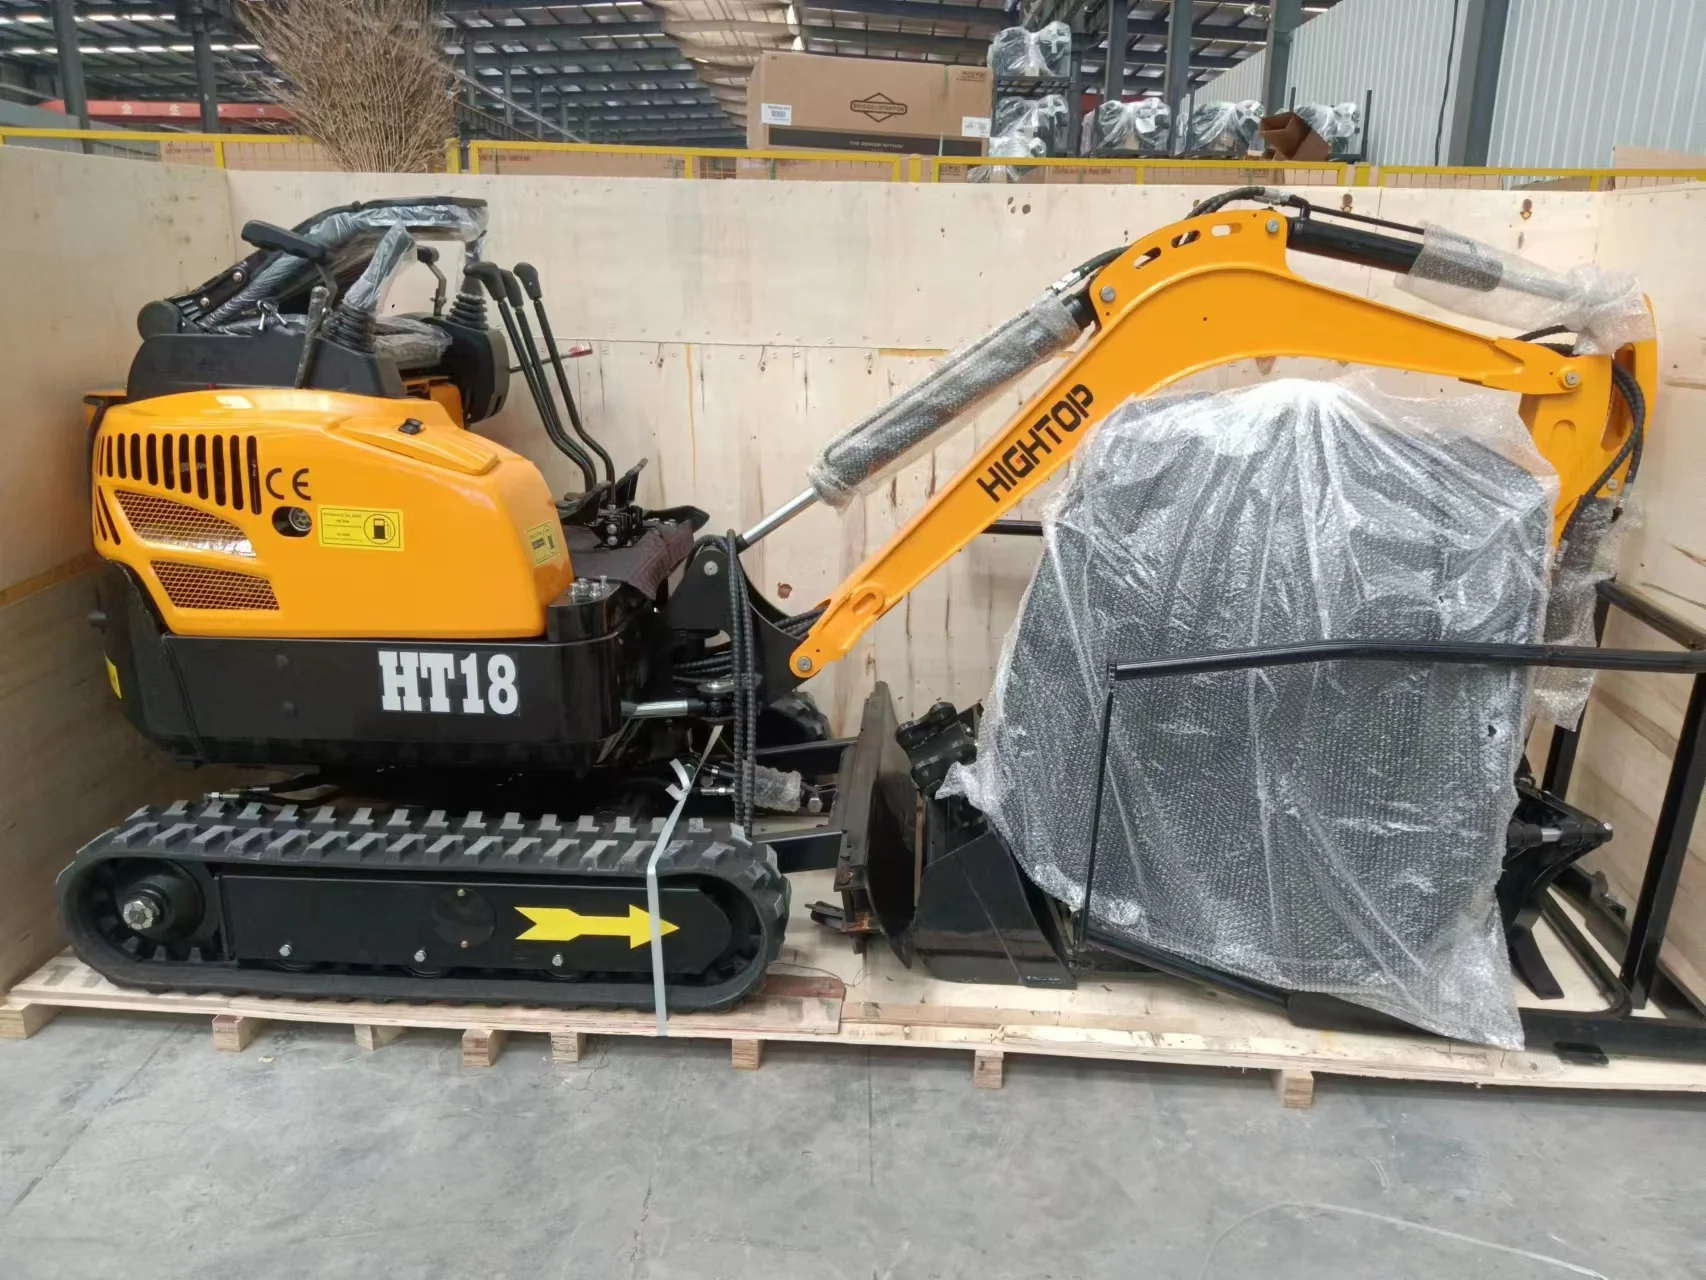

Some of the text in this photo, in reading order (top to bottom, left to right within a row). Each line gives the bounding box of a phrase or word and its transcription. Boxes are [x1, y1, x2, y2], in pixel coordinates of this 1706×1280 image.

[976, 384, 1093, 503] HIGHTOP
[265, 467, 311, 501] CE
[378, 651, 518, 715] HT18
